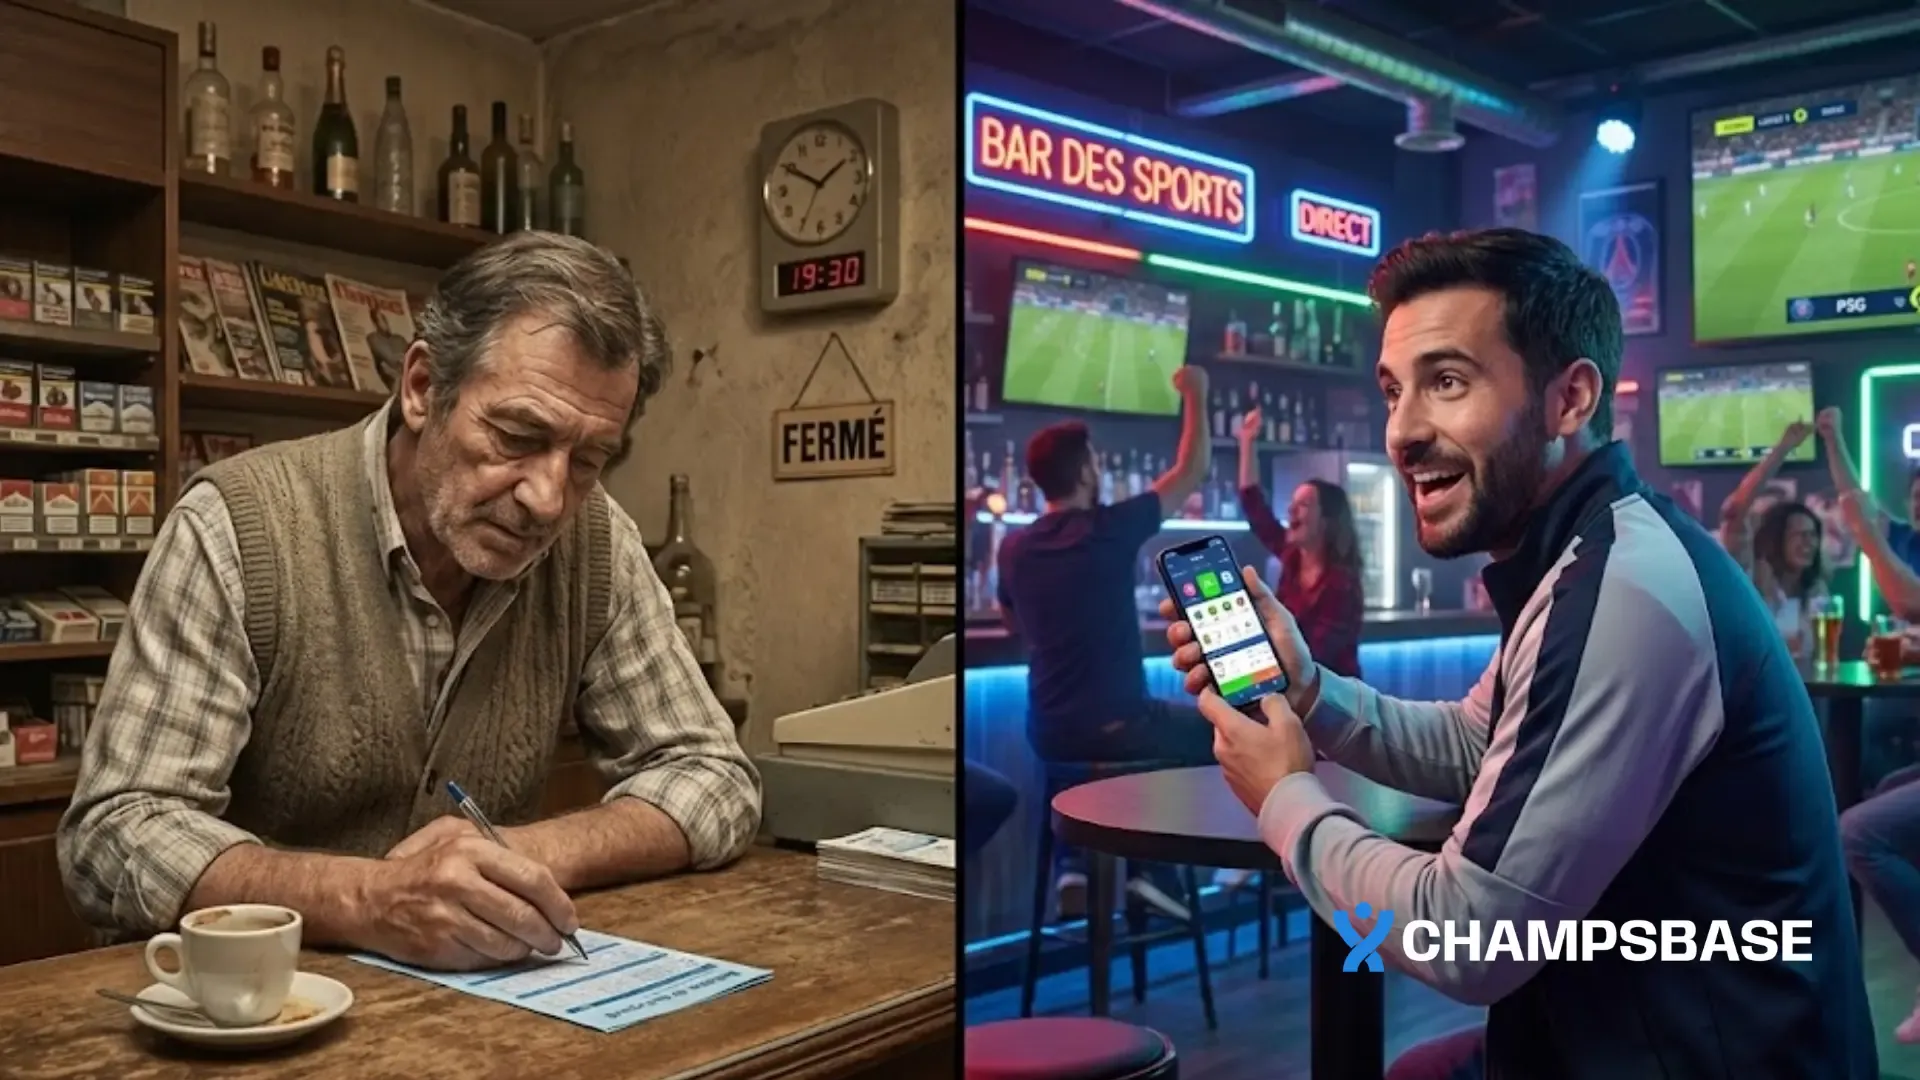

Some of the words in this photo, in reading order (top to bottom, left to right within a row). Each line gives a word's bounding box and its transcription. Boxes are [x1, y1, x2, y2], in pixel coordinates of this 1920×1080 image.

[981, 116, 1053, 179] BAR
[1061, 137, 1126, 196] DES
[1132, 155, 1245, 225] SPORTS
[1298, 201, 1372, 246] DIRECT
[792, 255, 860, 291] 19:30
[1836, 297, 1867, 313] PSG
[783, 406, 886, 464] FERMÉ
